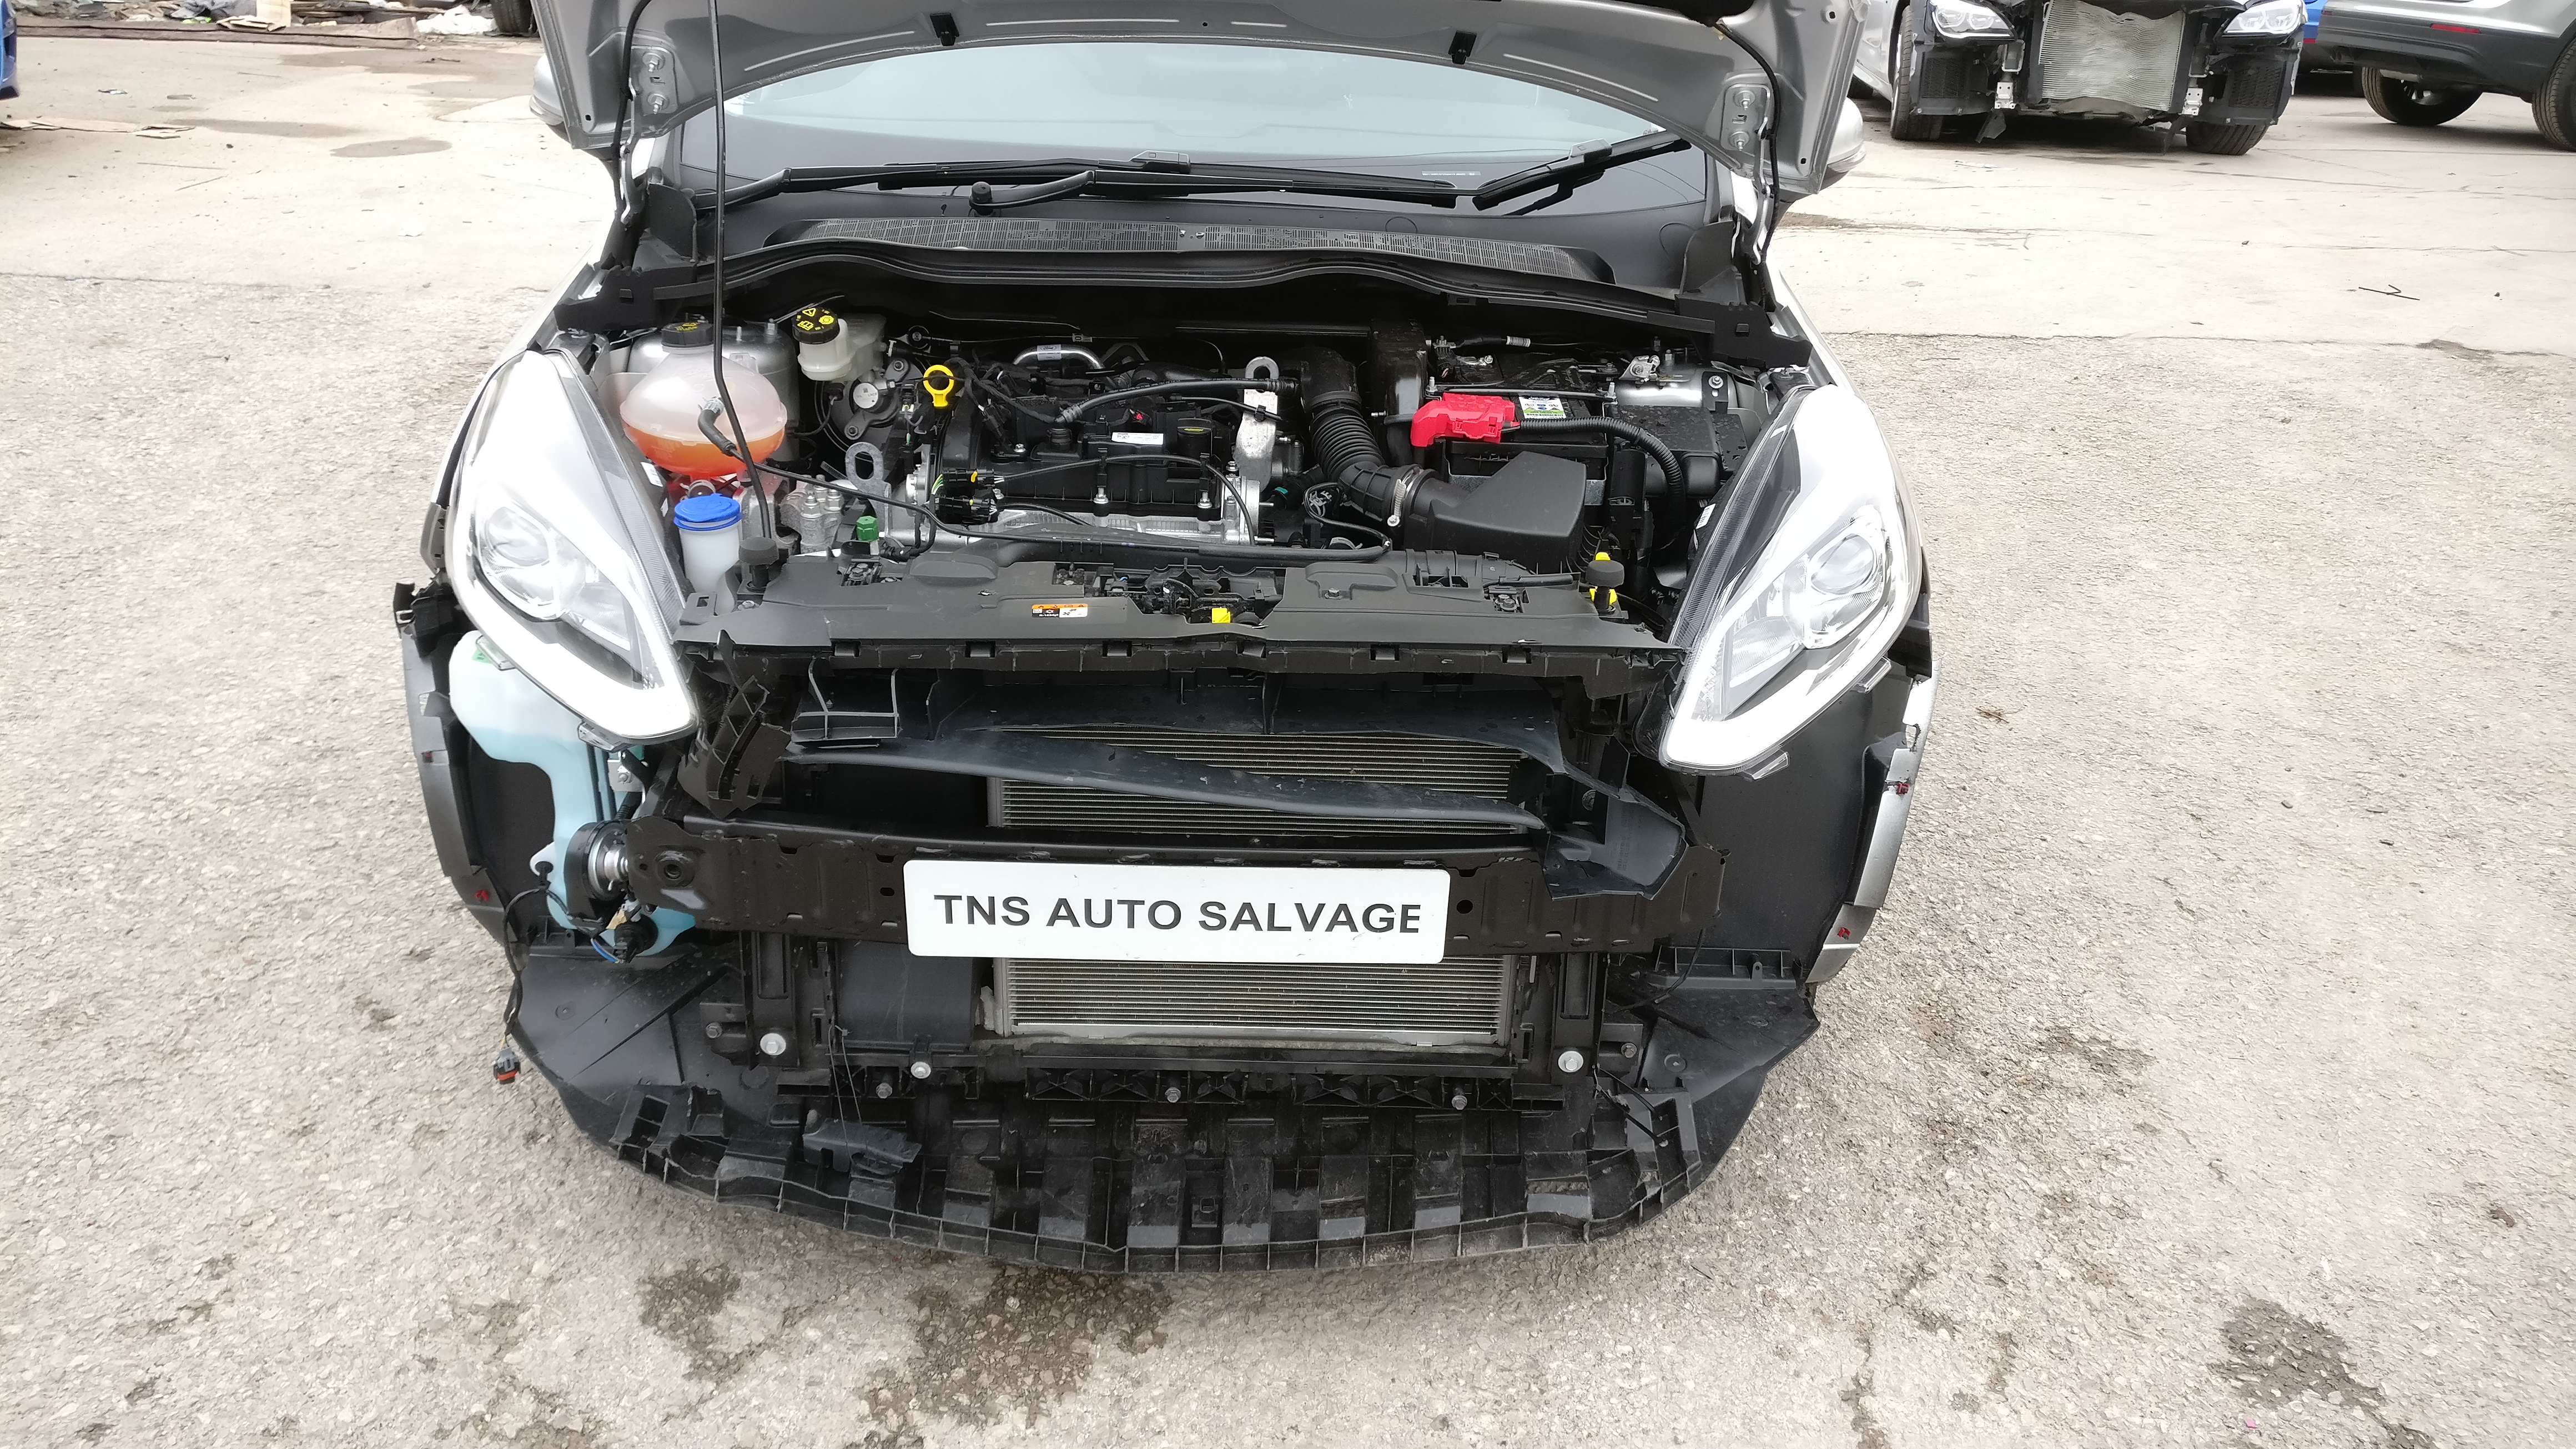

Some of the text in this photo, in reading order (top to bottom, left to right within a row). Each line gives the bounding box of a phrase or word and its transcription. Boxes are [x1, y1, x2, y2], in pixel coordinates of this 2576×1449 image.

[934, 894, 1421, 934] TNS AUTO SALVAGE
